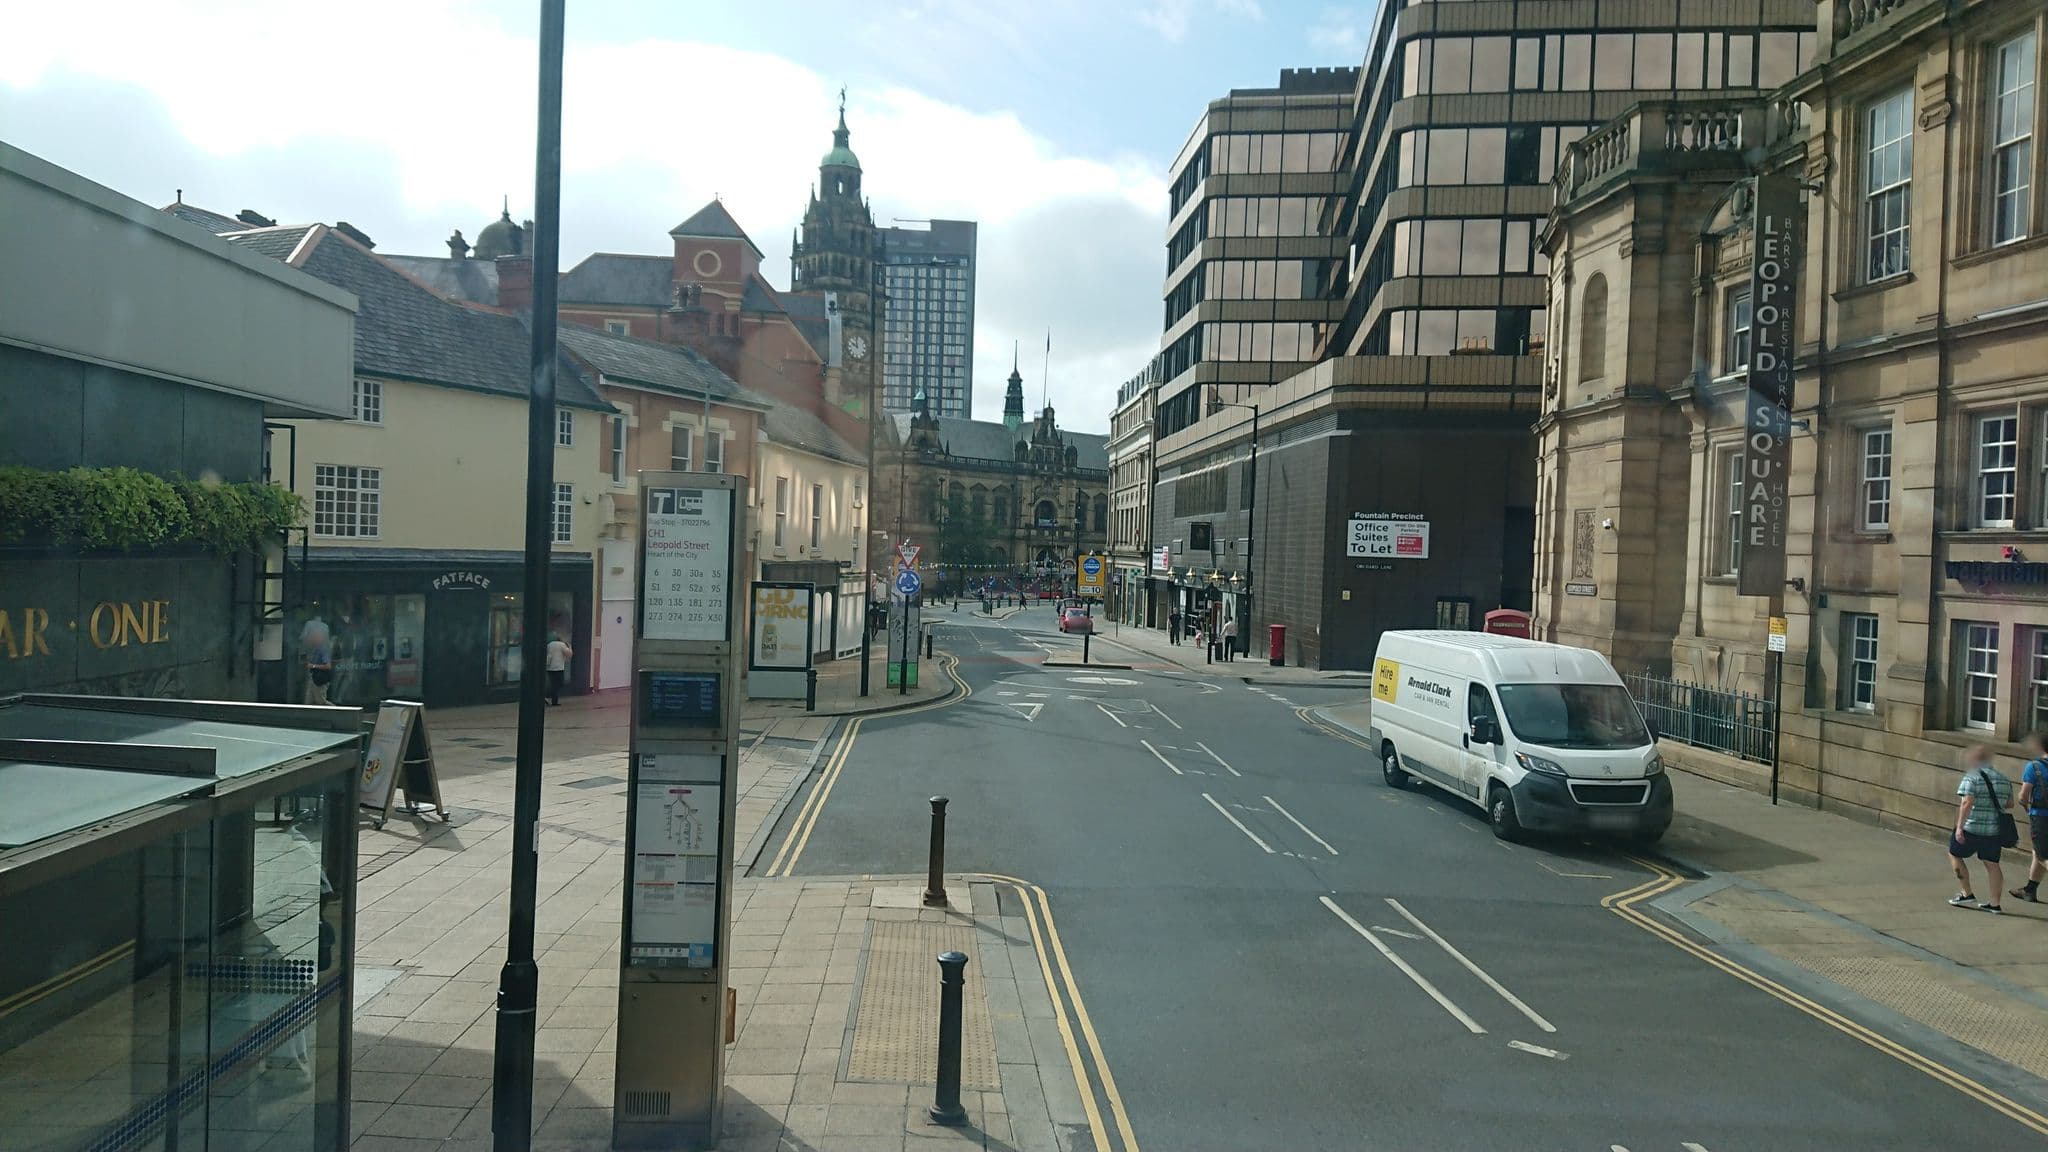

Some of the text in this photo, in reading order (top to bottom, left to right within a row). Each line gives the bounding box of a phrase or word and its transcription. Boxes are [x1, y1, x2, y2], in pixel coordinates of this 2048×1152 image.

[1756, 215, 1781, 372] LEOPOLD
[1771, 217, 1792, 547] BARS RESTAURANTS HOTEL
[1749, 406, 1773, 547] SQUARE
[1354, 512, 1425, 521] Fountain Precinct
[1355, 522, 1389, 532] Office
[648, 529, 665, 538] CH1
[1355, 532, 1389, 542] Suites
[648, 539, 710, 551] Leopold Street
[1350, 543, 1366, 553] To
[1371, 543, 1393, 554] Let
[685, 552, 698, 560] City
[654, 568, 660, 577] 6
[671, 568, 682, 577] 30
[711, 569, 721, 578] 35
[432, 571, 491, 590] FATFACE
[651, 583, 660, 591] 51
[671, 583, 681, 592] 52
[711, 584, 721, 593] 95
[649, 598, 663, 606] 120
[668, 598, 683, 607] 135
[689, 598, 702, 607] 181
[688, 613, 703, 622] 275
[89, 599, 170, 650] ONE
[1379, 665, 1394, 681] Hire
[1378, 683, 1389, 696] me
[1407, 676, 1452, 698] Arnold Clark
